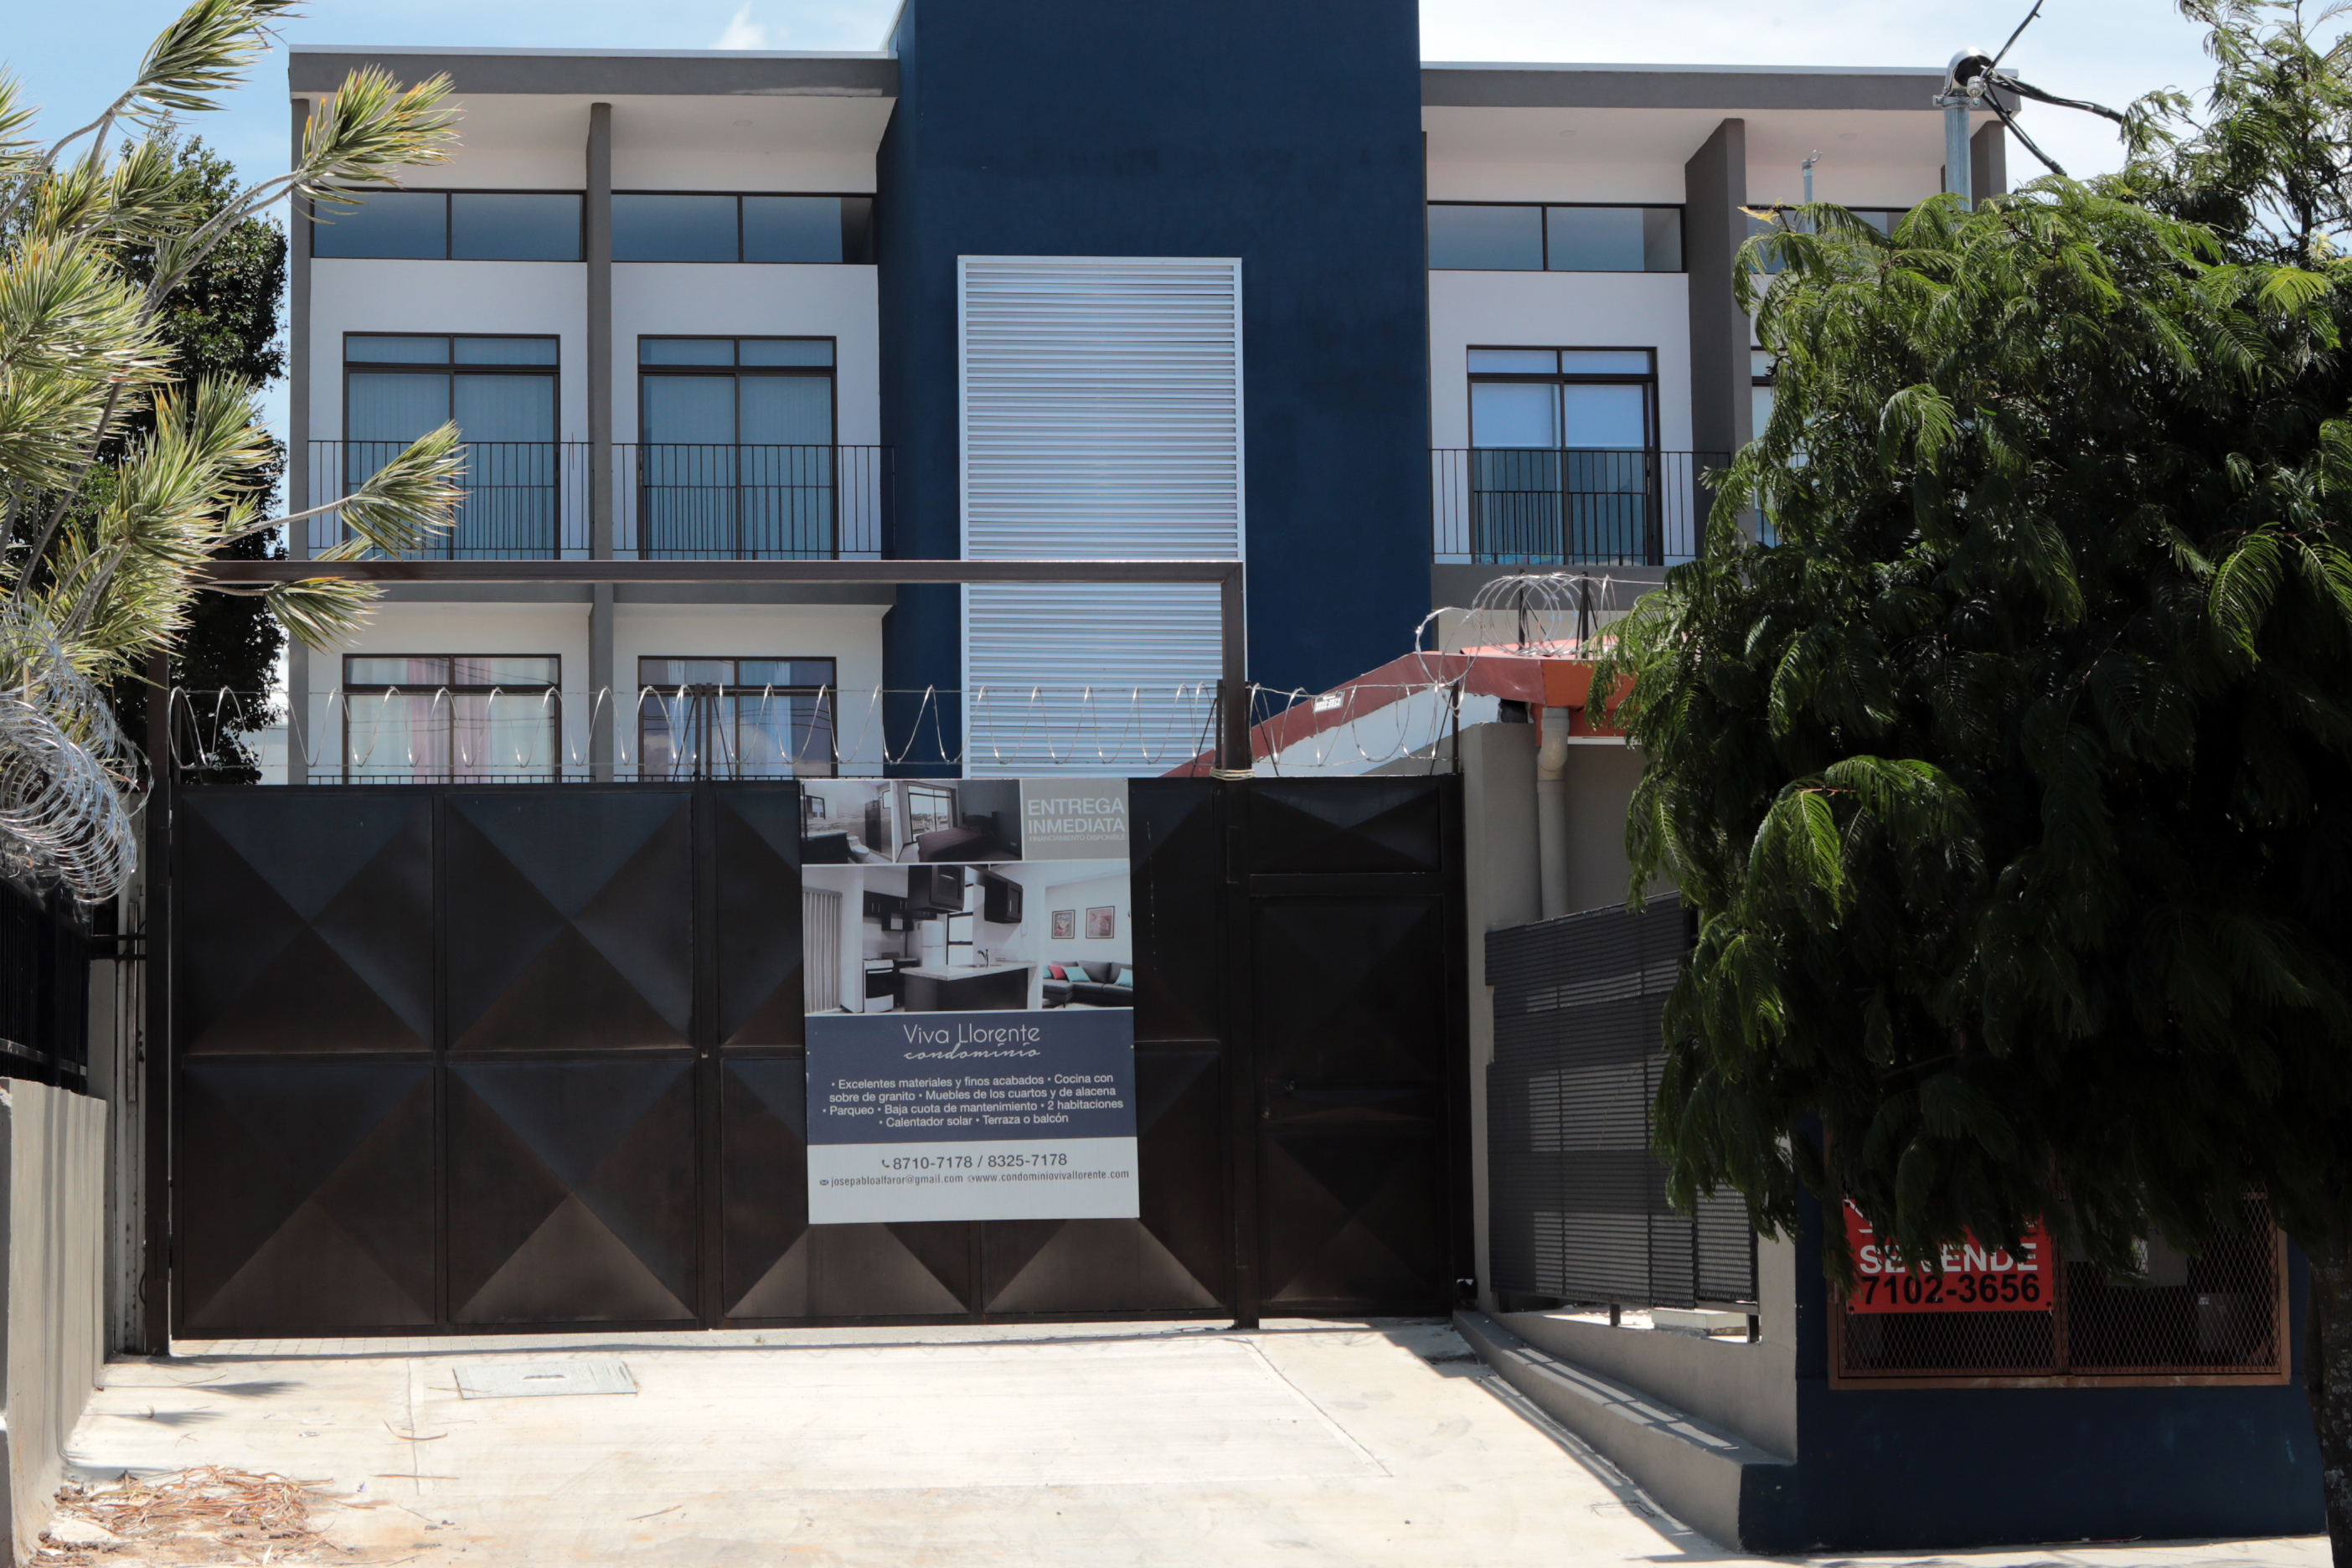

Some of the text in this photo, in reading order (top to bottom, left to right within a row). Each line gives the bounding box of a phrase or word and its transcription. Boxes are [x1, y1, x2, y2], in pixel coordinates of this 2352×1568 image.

[1028, 797, 1125, 816] ENTREGA
[1029, 818, 1125, 834] INMEDIATA
[1029, 834, 1086, 843] FINANCIAMIENTO
[903, 1024, 1040, 1044] Viva Llorente
[904, 1042, 1040, 1060] condominio
[838, 1074, 1113, 1090] Excelentes materiales y finos acabados Cocina con
[829, 1087, 1116, 1104] sobre de granito Muebles de los cuartos y de alacena
[830, 1099, 1123, 1117] Parqueo Baja cuota de mantenimiento 2 habitaciones
[886, 1117, 944, 1127] Calentador
[947, 1116, 972, 1126] solar
[983, 1115, 1021, 1125] Terraza
[1033, 1113, 1069, 1124] balcón
[893, 1156, 972, 1170] 8710-7178
[988, 1153, 1067, 1168] 8325-7178
[831, 1171, 1129, 1188] josepabloalfaror@gmail.com www.condominiovivallorente.com
[1863, 1273, 2040, 1304] 7102-3656
